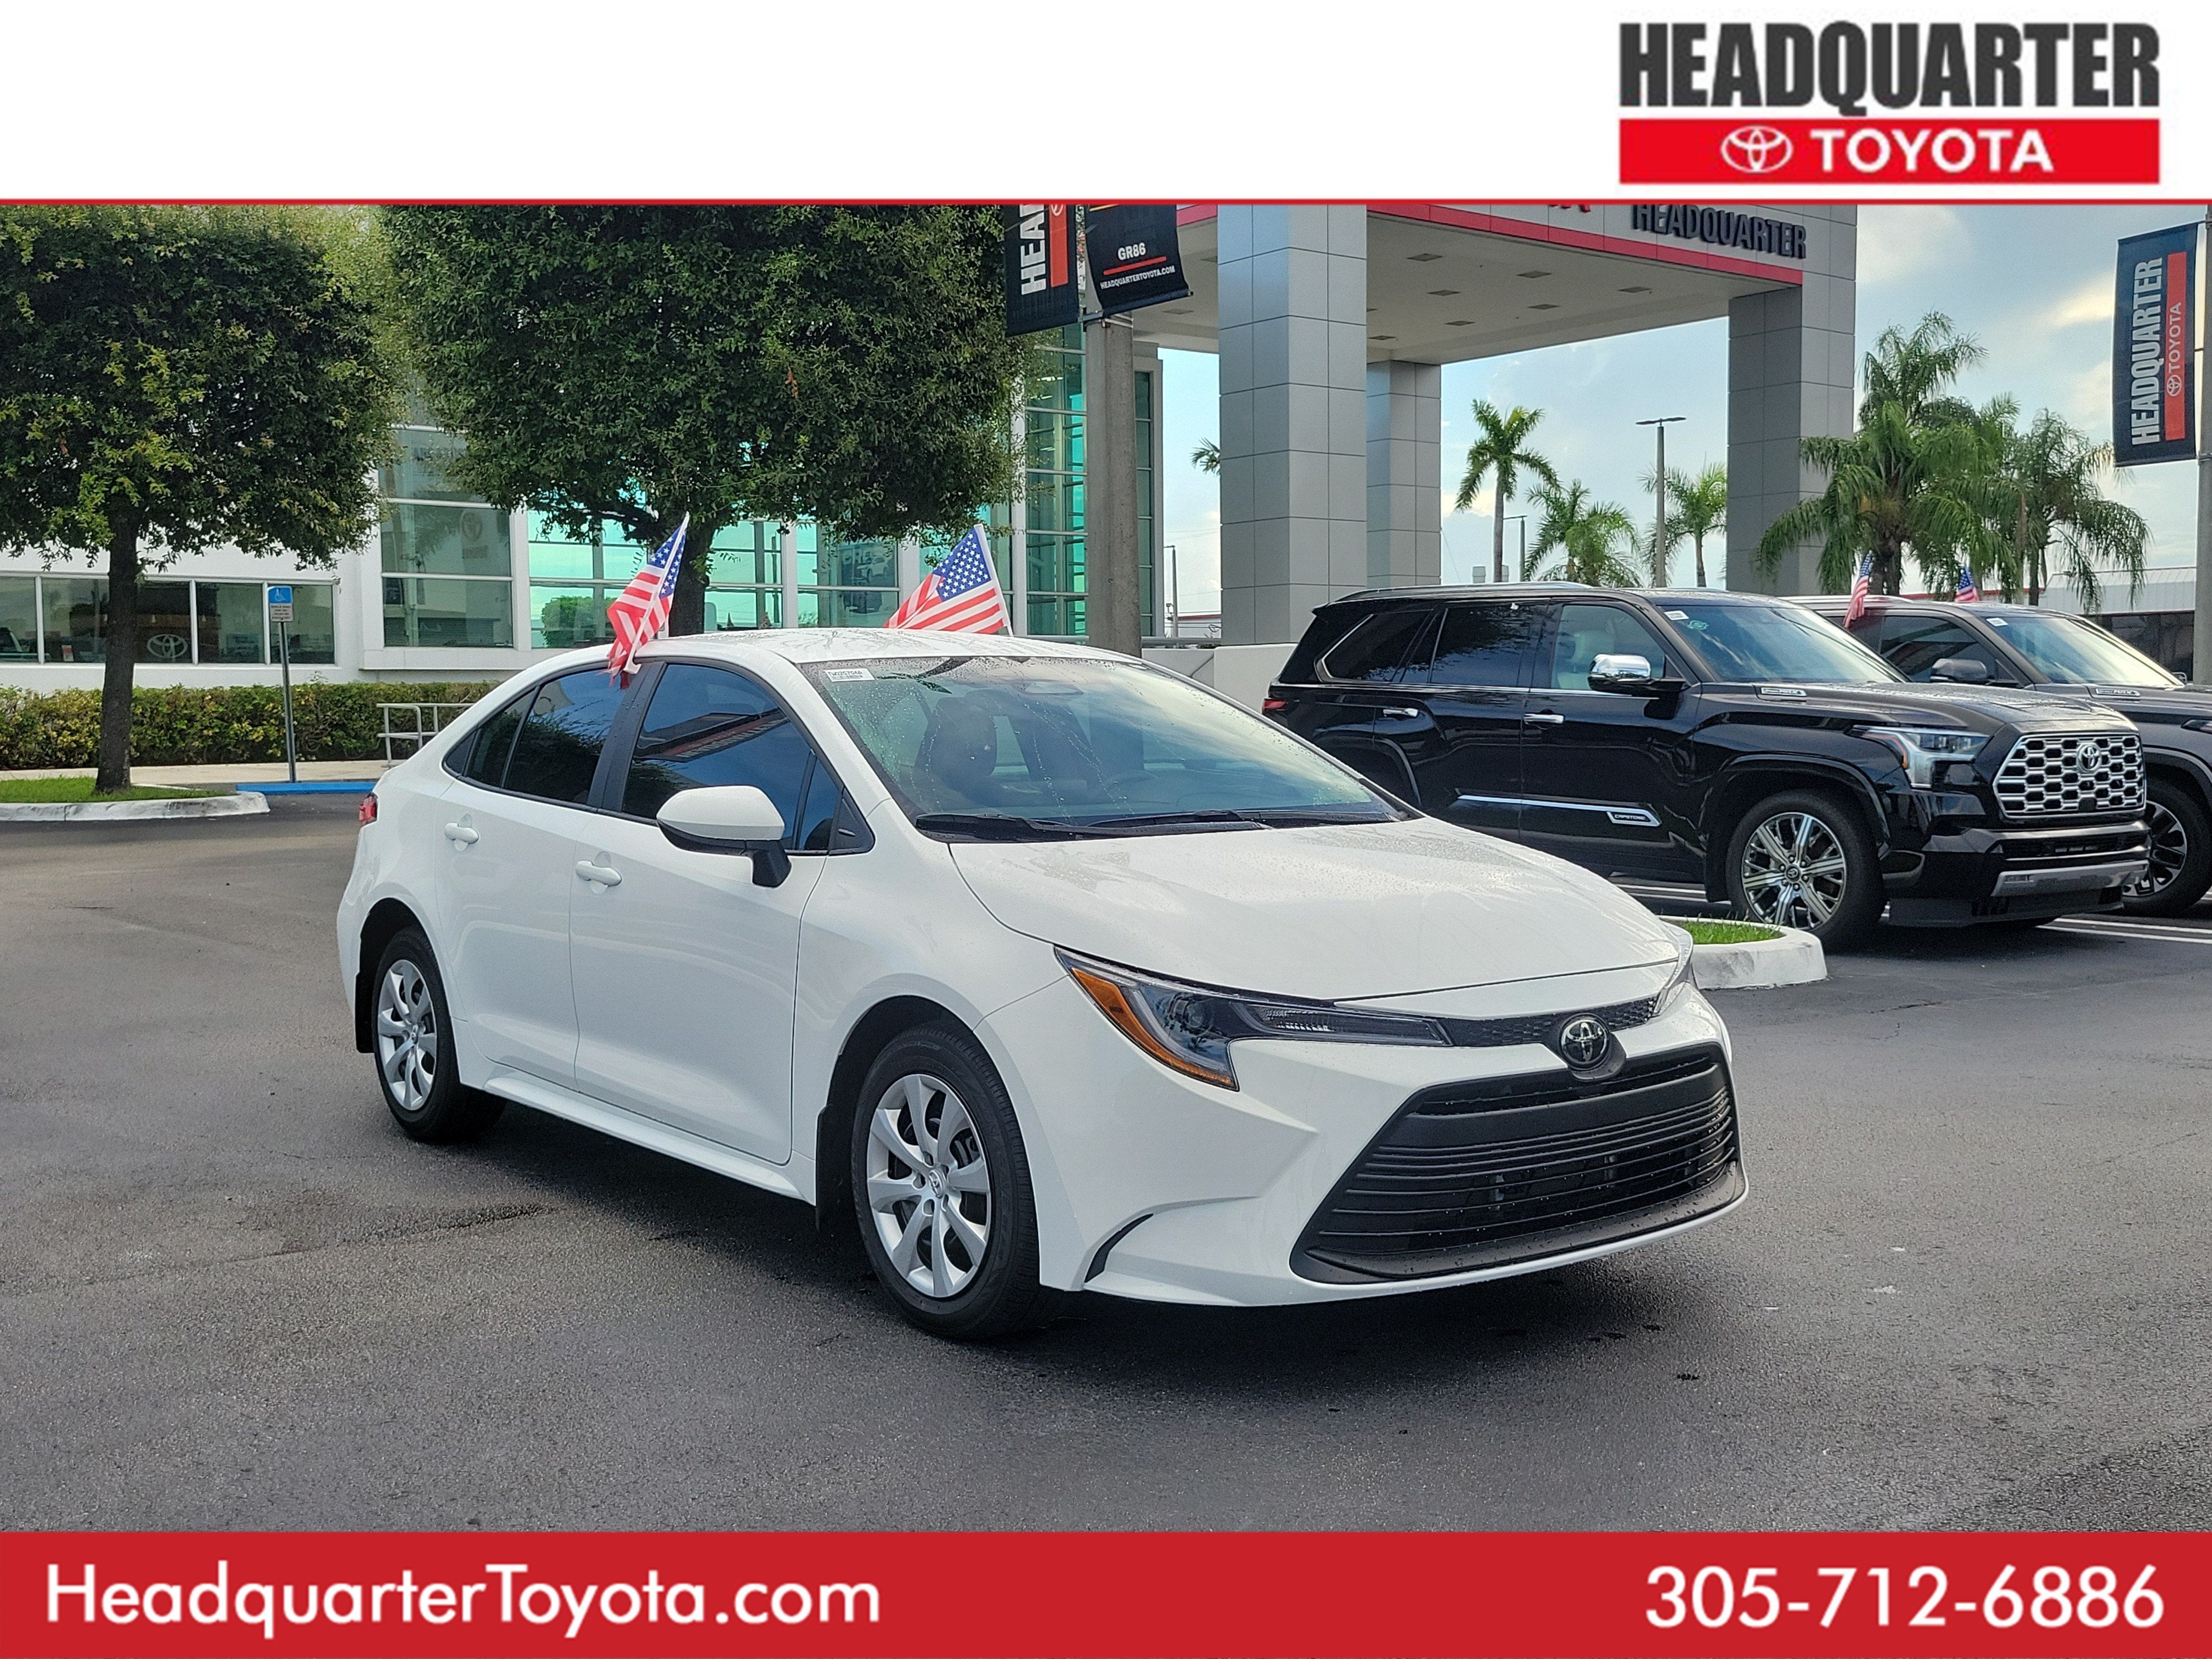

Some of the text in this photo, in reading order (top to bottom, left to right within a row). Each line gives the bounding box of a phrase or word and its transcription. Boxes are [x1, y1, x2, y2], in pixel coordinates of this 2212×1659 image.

[1118, 242, 1146, 261] GR86
[1632, 204, 1806, 259] HEADQUARTER
[1100, 265, 1175, 289] HEADQUARTERTOYOTA.COM
[2131, 257, 2164, 445] HEADQUARTER
[2168, 302, 2181, 372] TOYOTA
